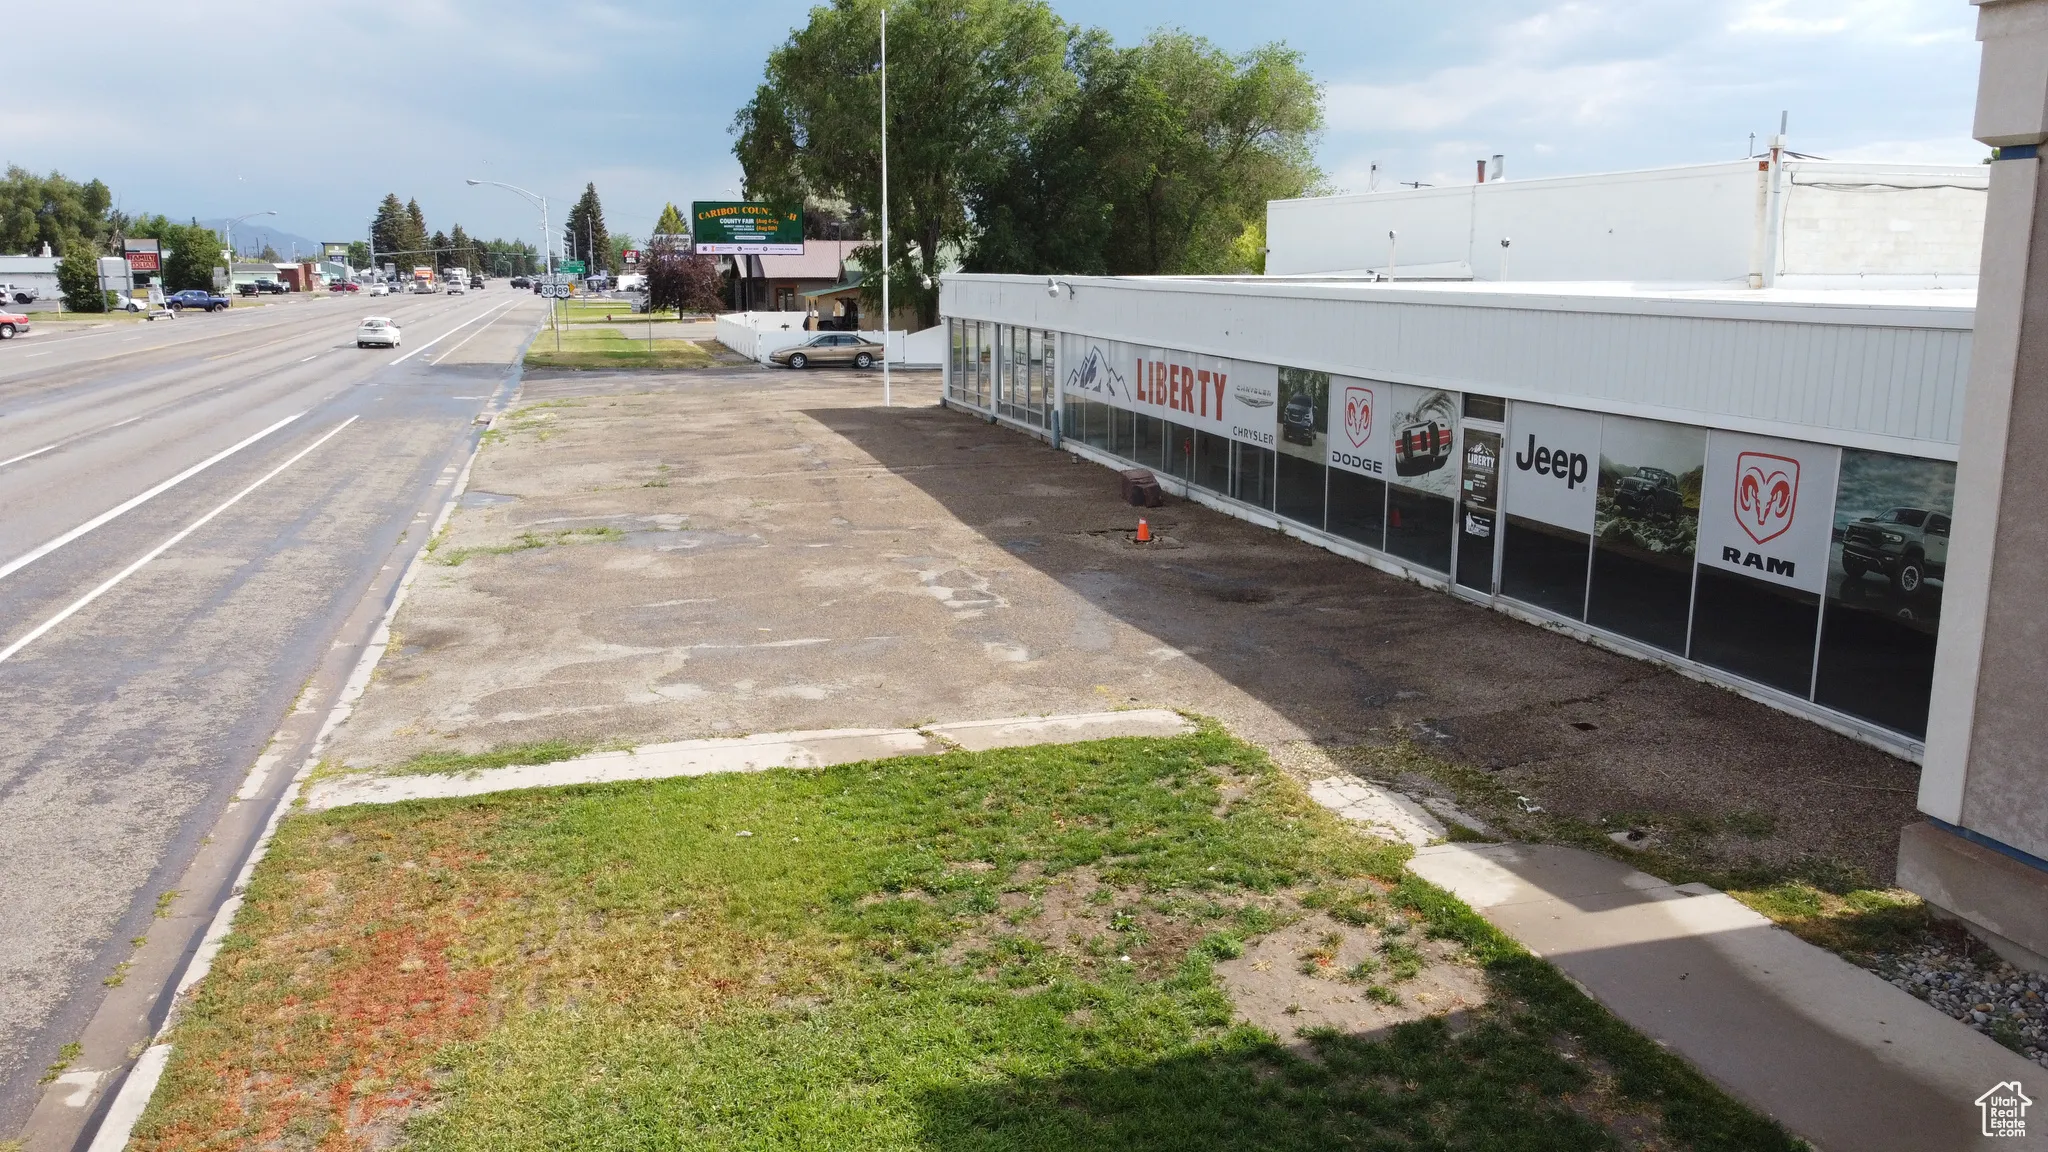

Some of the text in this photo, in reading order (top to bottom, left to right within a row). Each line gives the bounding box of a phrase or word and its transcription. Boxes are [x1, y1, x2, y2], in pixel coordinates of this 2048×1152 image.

[698, 207, 740, 220] CARIBOU
[742, 206, 773, 216] COUN
[130, 254, 156, 262] FAMILY
[543, 287, 554, 295] 30
[557, 287, 569, 295] 89
[1137, 358, 1227, 421] LIBERTY
[1236, 385, 1271, 397] CHRYSLER
[1233, 426, 1274, 445] CHRYSLER
[1332, 451, 1382, 473] DODGE
[1468, 452, 1495, 468] LIBERTY
[1516, 434, 1588, 490] Jeep
[1723, 546, 1795, 578] RAM
